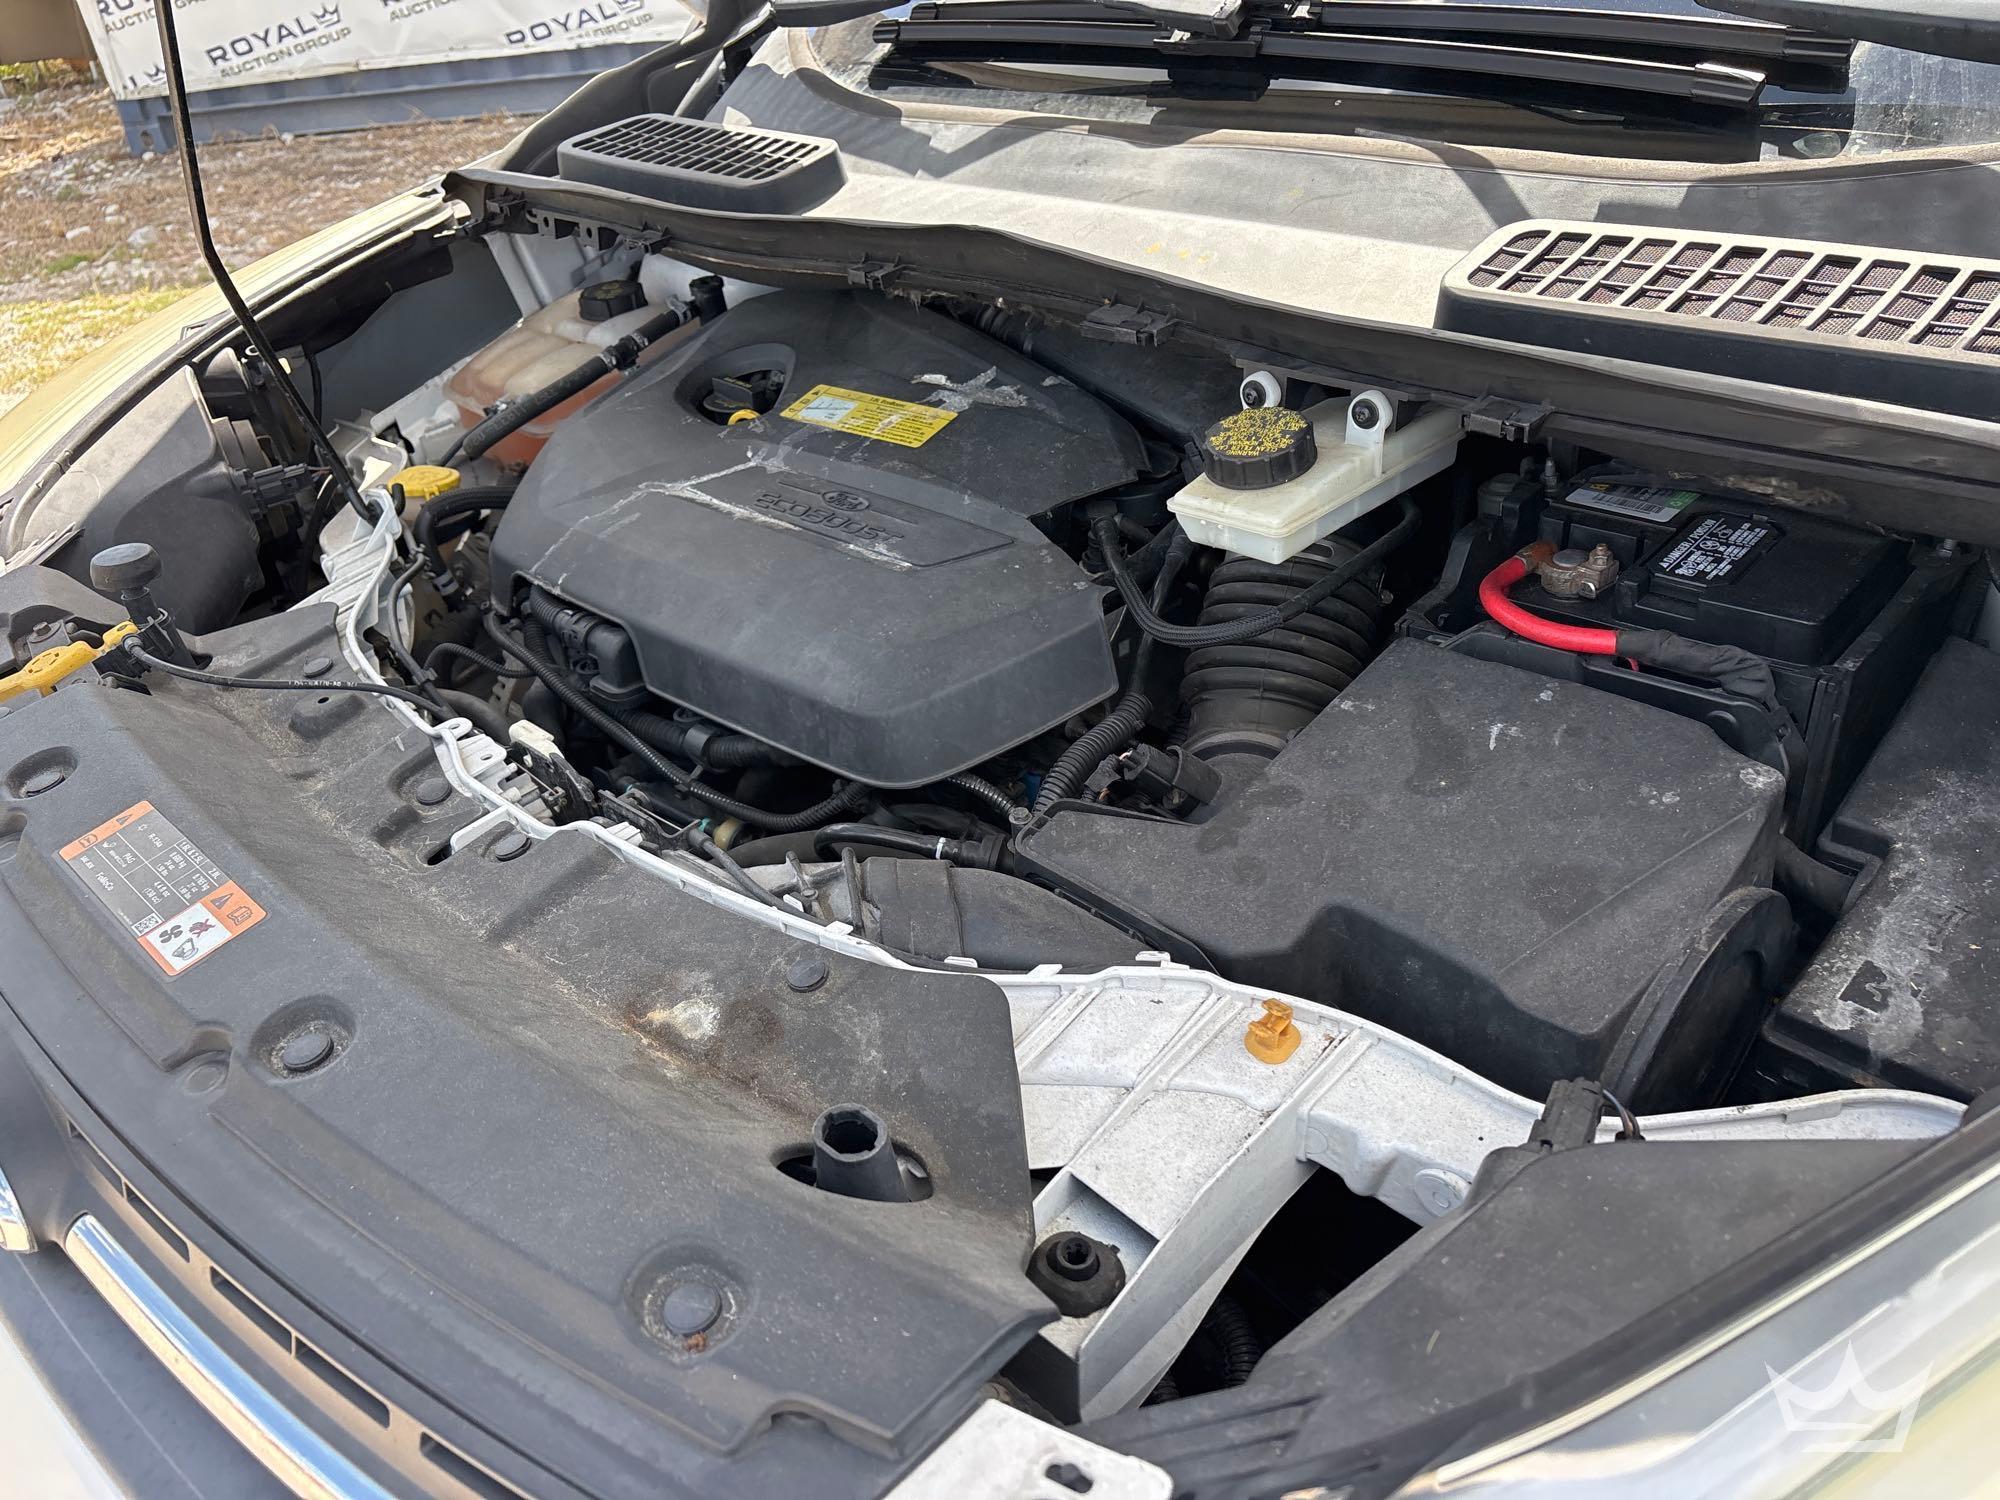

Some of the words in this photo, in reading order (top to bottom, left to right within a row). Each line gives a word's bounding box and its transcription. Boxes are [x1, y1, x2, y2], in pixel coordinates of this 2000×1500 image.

[105, 8, 157, 34] AUCTIO
[389, 0, 458, 23] AUCTI
[206, 16, 316, 66] ROYAL
[219, 46, 293, 79] AUCTION
[293, 27, 351, 54] GROUP
[754, 493, 905, 542] ECOBOOST
[1665, 541, 1692, 564] DANGER
[1690, 519, 1717, 540] POISON
[122, 852, 136, 863] PAG
[96, 871, 114, 891] FoMoCo
